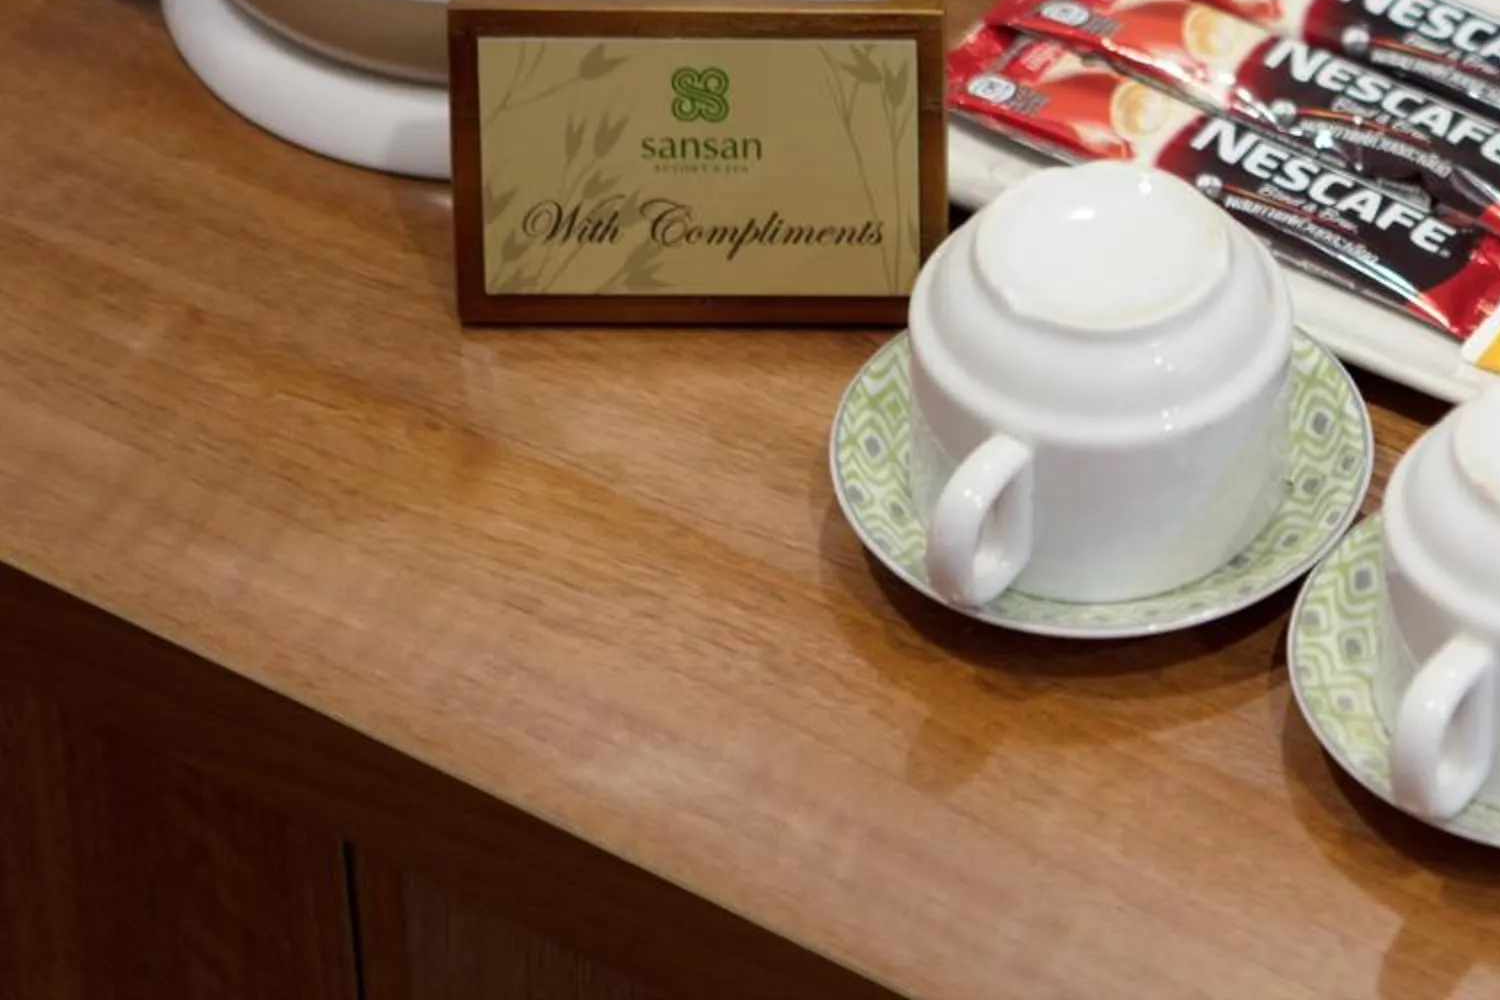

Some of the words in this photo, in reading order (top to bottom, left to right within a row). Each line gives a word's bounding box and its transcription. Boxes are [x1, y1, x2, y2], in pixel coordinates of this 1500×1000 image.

[641, 136, 762, 161] sansan
[522, 194, 622, 245] With
[639, 198, 884, 261] Compliments
